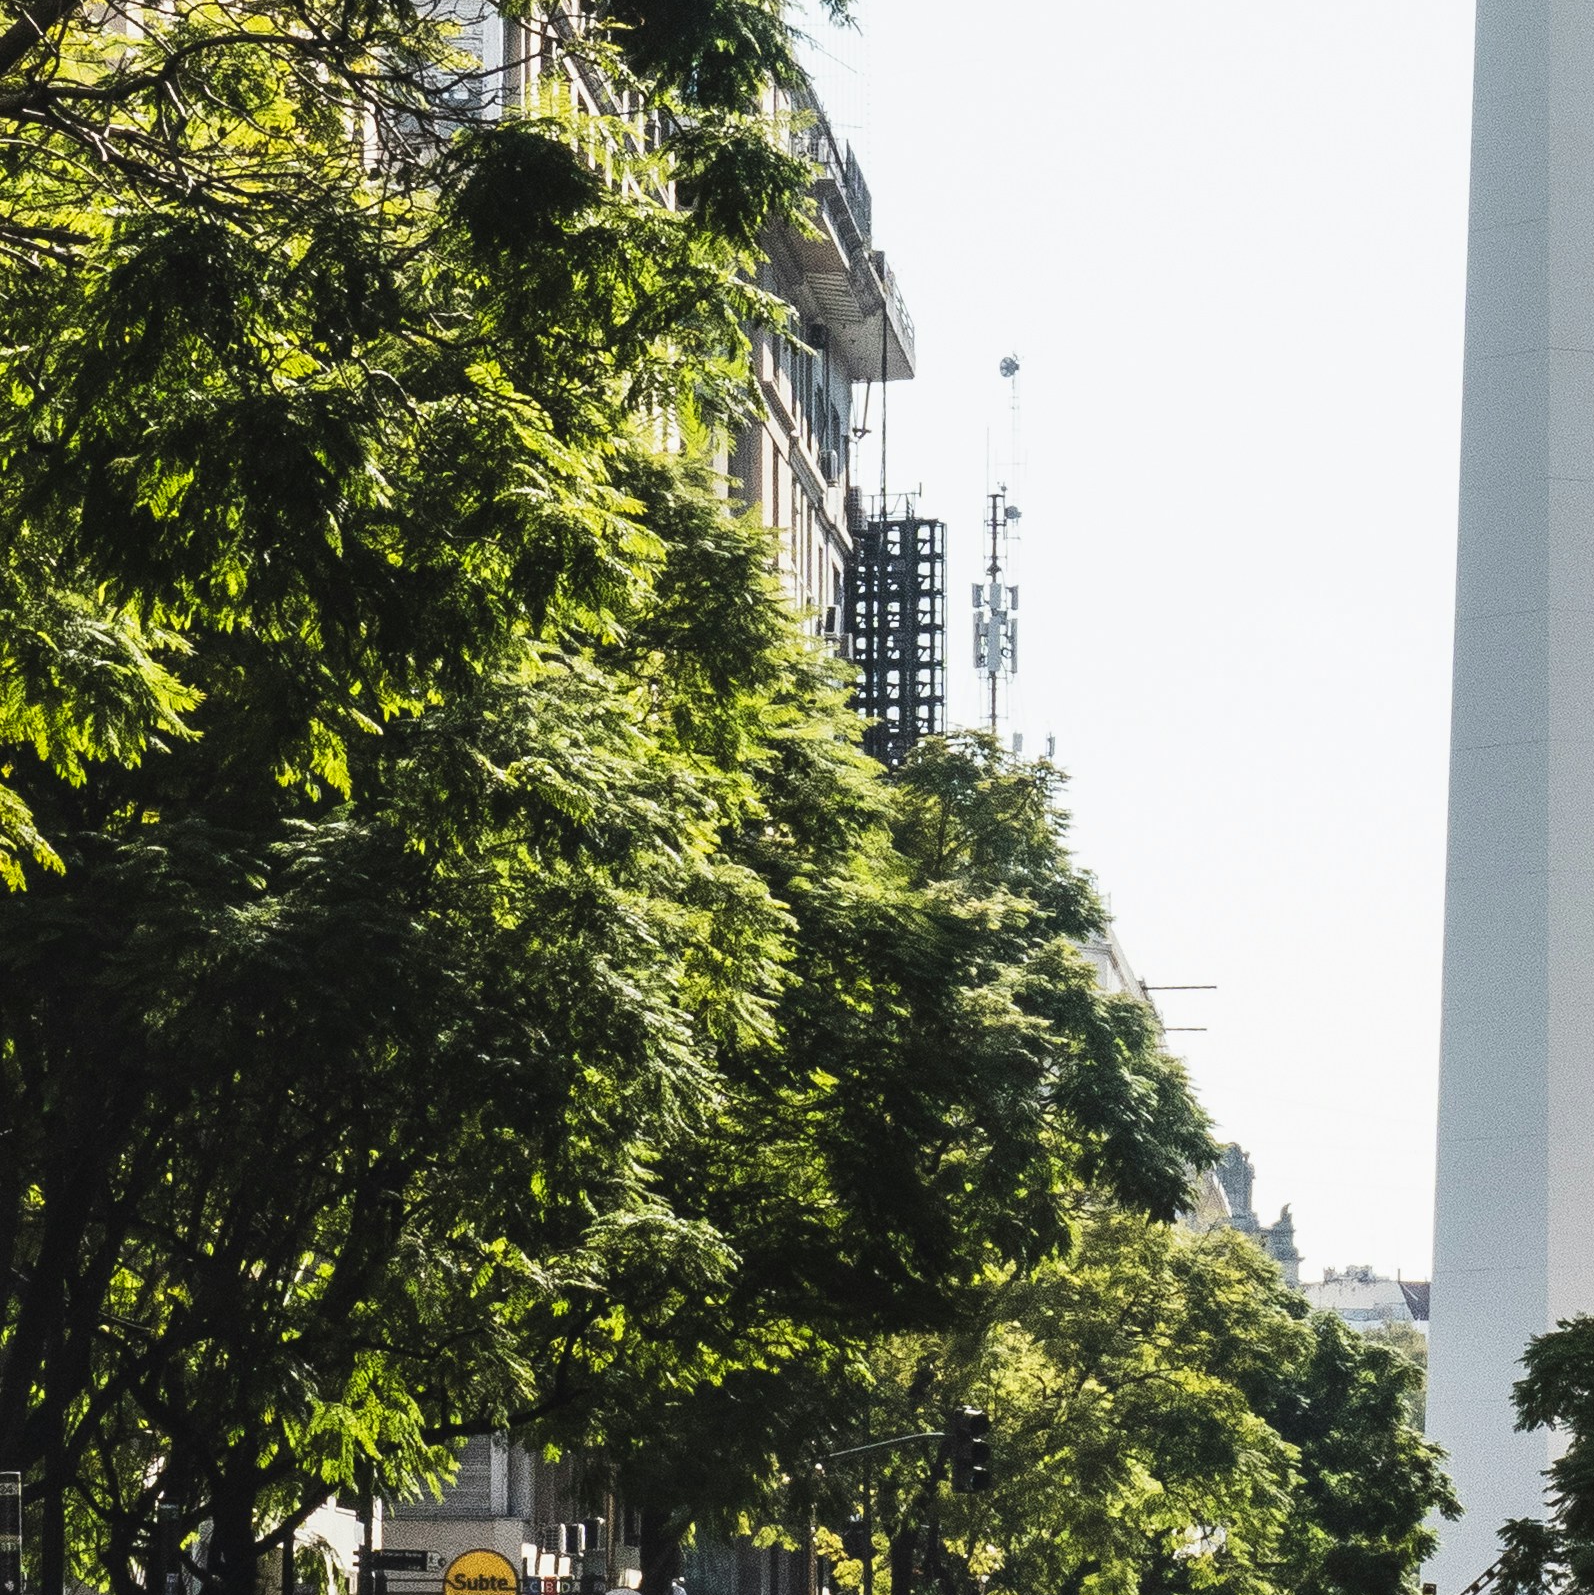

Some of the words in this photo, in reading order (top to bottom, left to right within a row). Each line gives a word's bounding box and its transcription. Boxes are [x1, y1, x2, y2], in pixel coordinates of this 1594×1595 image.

[451, 1573, 509, 1591] Subte
[529, 1581, 538, 1594] C
[545, 1581, 554, 1594] B
[561, 1581, 571, 1594] D
